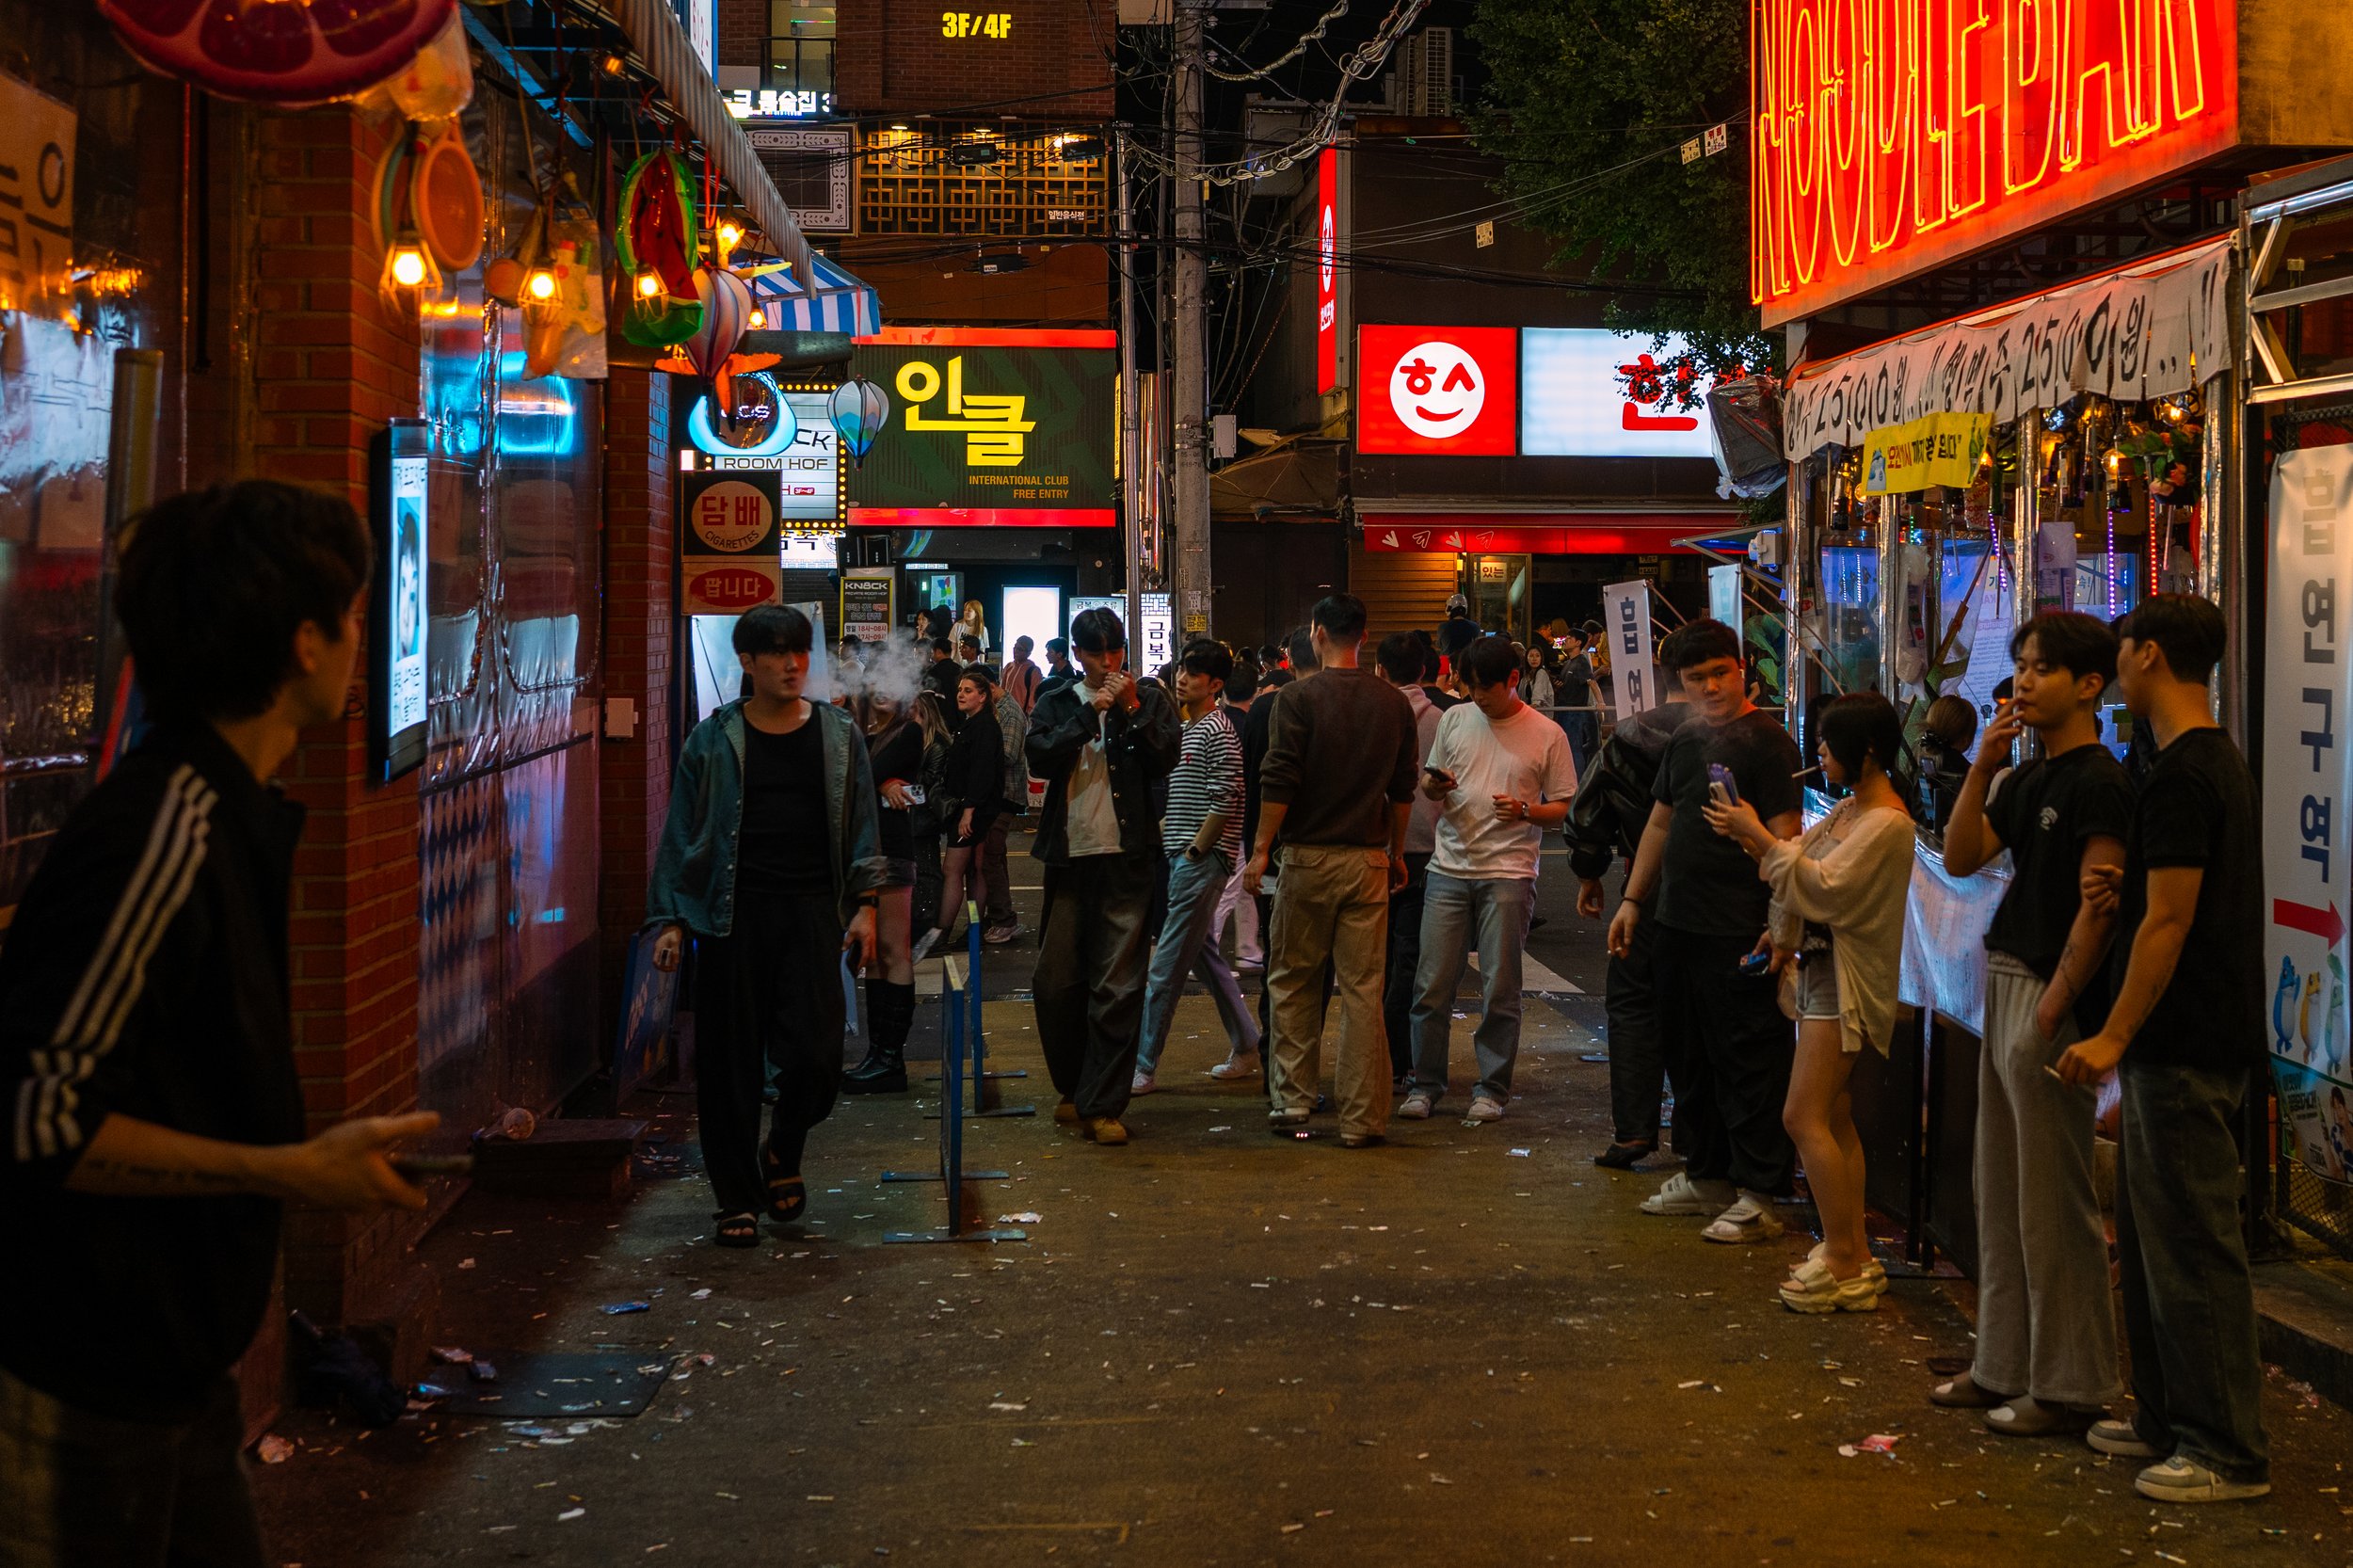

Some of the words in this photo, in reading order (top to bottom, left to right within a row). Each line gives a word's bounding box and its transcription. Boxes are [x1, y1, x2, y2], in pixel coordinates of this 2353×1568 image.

[942, 12, 1011, 39] 3F/4F
[1048, 210, 1084, 220] 일반음식점
[896, 356, 1036, 466] 인클
[724, 457, 782, 470] ROOM
[789, 457, 828, 470] HOF
[969, 475, 1042, 486] INTERNATIONAL
[1045, 475, 1069, 486] CLUB
[1014, 489, 1036, 499] FREE
[1039, 489, 1069, 499] ENTRY
[701, 496, 760, 526] 담배
[705, 529, 760, 549] CIGARETTES
